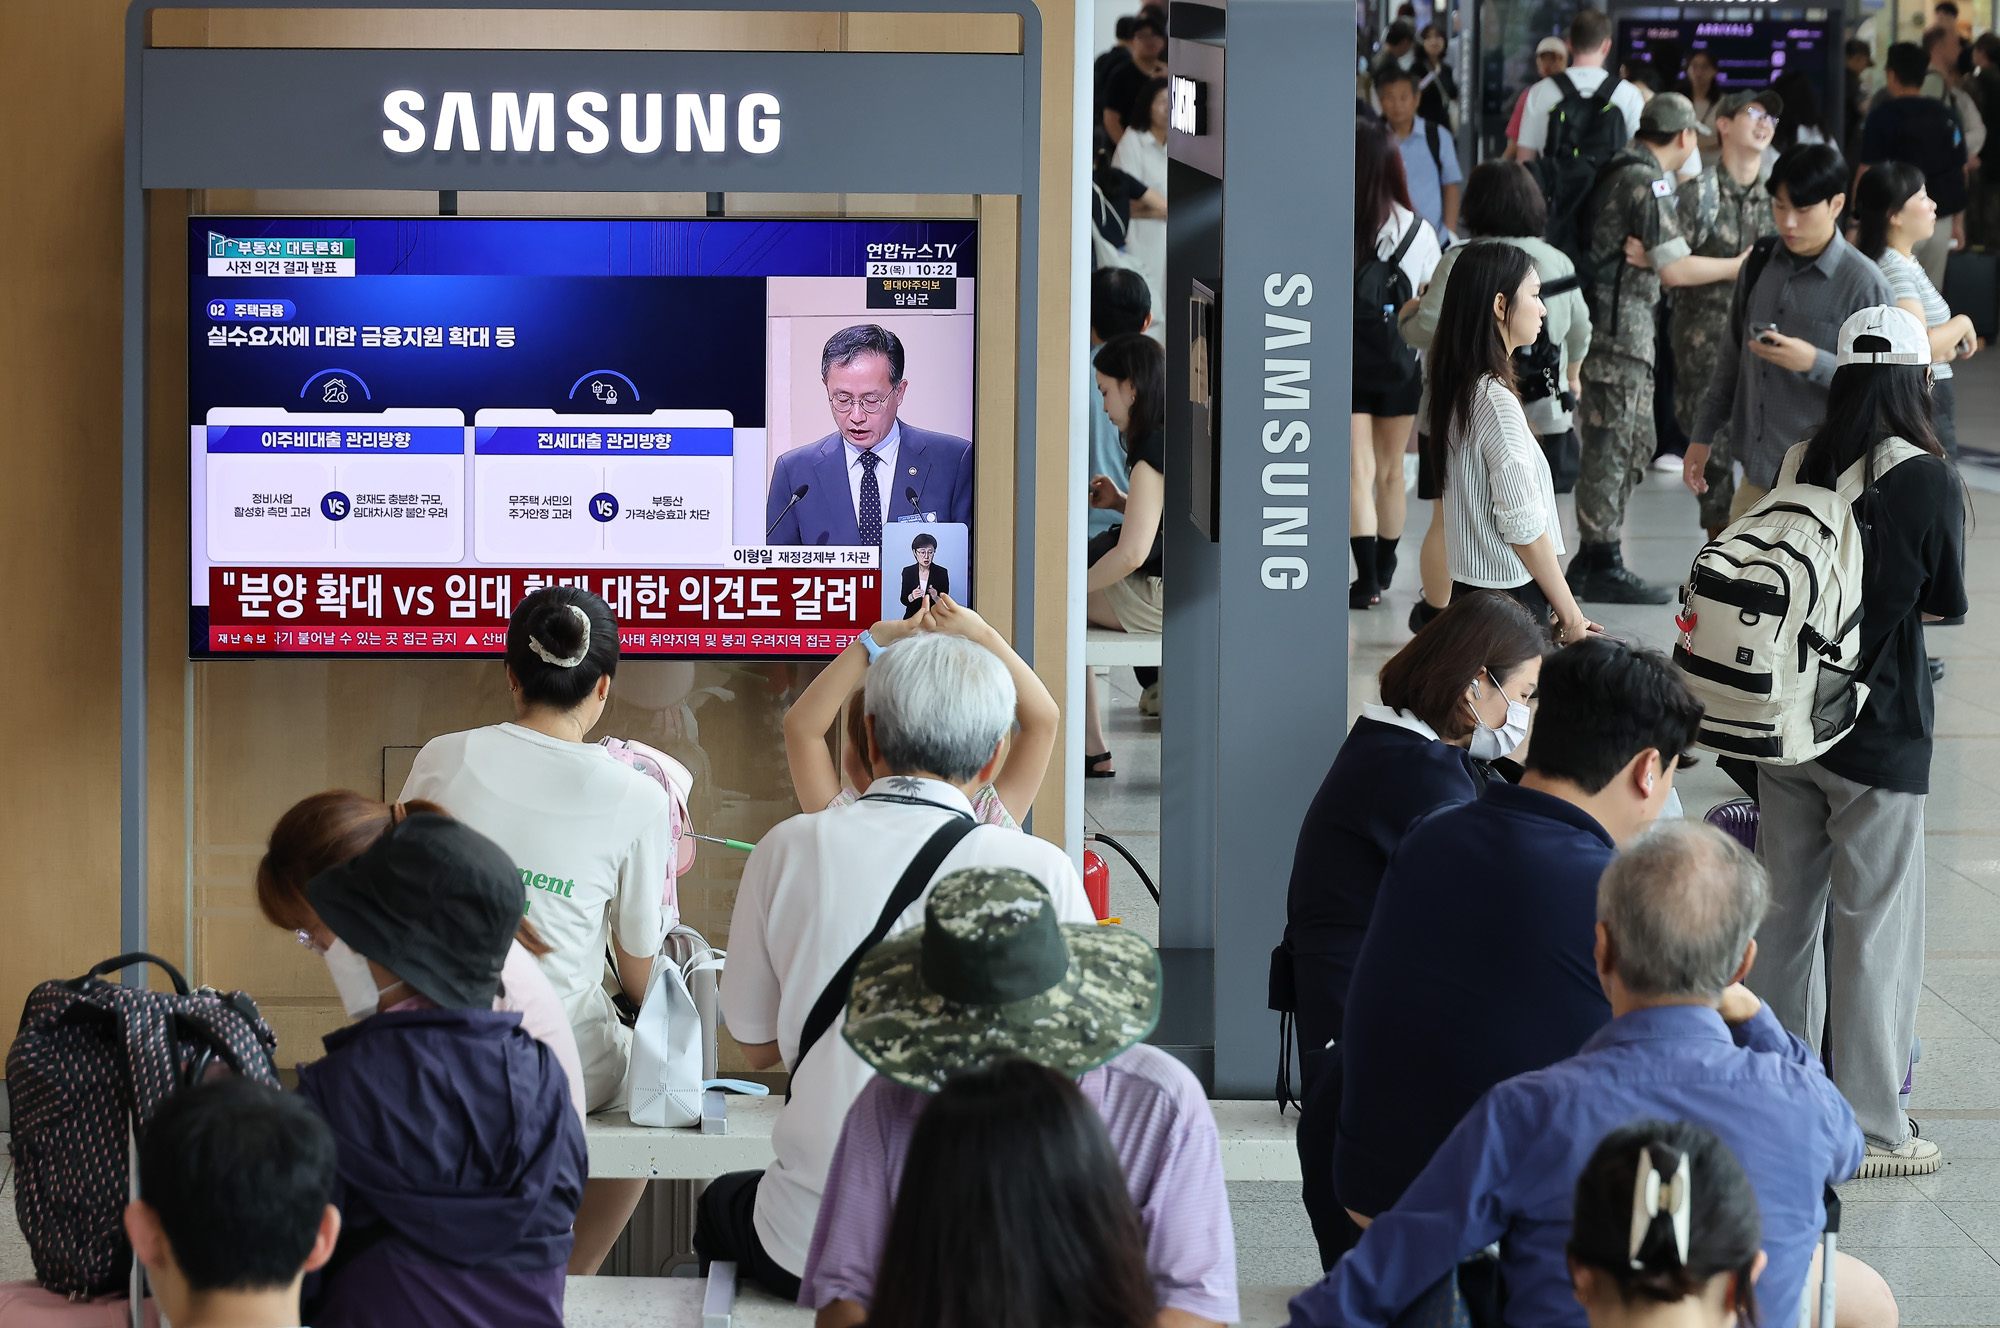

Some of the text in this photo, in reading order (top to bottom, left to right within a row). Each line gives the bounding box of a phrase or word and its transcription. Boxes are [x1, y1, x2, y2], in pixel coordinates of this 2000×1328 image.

[382, 89, 782, 155] SAMSUNG
[237, 241, 344, 256] 부동산 대토론회
[226, 260, 337, 275] 사전 의견 결과 발표
[916, 264, 953, 276] 10:22
[882, 279, 941, 291] 열대야주의보
[893, 292, 929, 306] 임실군
[210, 303, 284, 318] 02 주택금융
[207, 325, 516, 348] 실수요자에 대한 금융지원 확대 등
[1260, 273, 1314, 591] SAMSUNG
[261, 431, 412, 449] 이주비대출 관리방향
[537, 432, 672, 450] 전세대출 관리방향
[252, 493, 293, 505] 정비사업
[356, 494, 443, 506] 현재도 충분한 규모,
[508, 495, 572, 507] 무주택 서민의
[652, 495, 684, 507] 부동산
[234, 506, 311, 518] 활성화 측면 고려
[327, 498, 346, 516] VS
[353, 507, 448, 519] 임대차시장 불안 우려
[508, 508, 572, 520] 주거안정 고려
[595, 500, 613, 518] VS
[625, 509, 711, 521] 가격상승효과 차단
[733, 549, 871, 564] 이형일 재정경제부 1차관
[223, 571, 307, 619] "분양
[315, 573, 382, 619] 확대
[392, 585, 435, 616] vs
[445, 574, 511, 620] 임대
[602, 574, 670, 620] 대한
[678, 575, 781, 621] 의견도
[790, 575, 874, 621] 갈려"
[297, 632, 336, 645] 불어날
[339, 632, 353, 646] 수
[356, 632, 382, 646] 있는
[385, 633, 399, 646] 곳
[402, 633, 428, 646] 접근
[431, 633, 457, 646] 금지
[613, 633, 645, 647] 사태
[649, 633, 700, 647] 취약지역
[704, 633, 717, 647] 및
[720, 633, 746, 648] 붕괴
[750, 634, 801, 648] 우려지역
[805, 634, 832, 648] 접근
